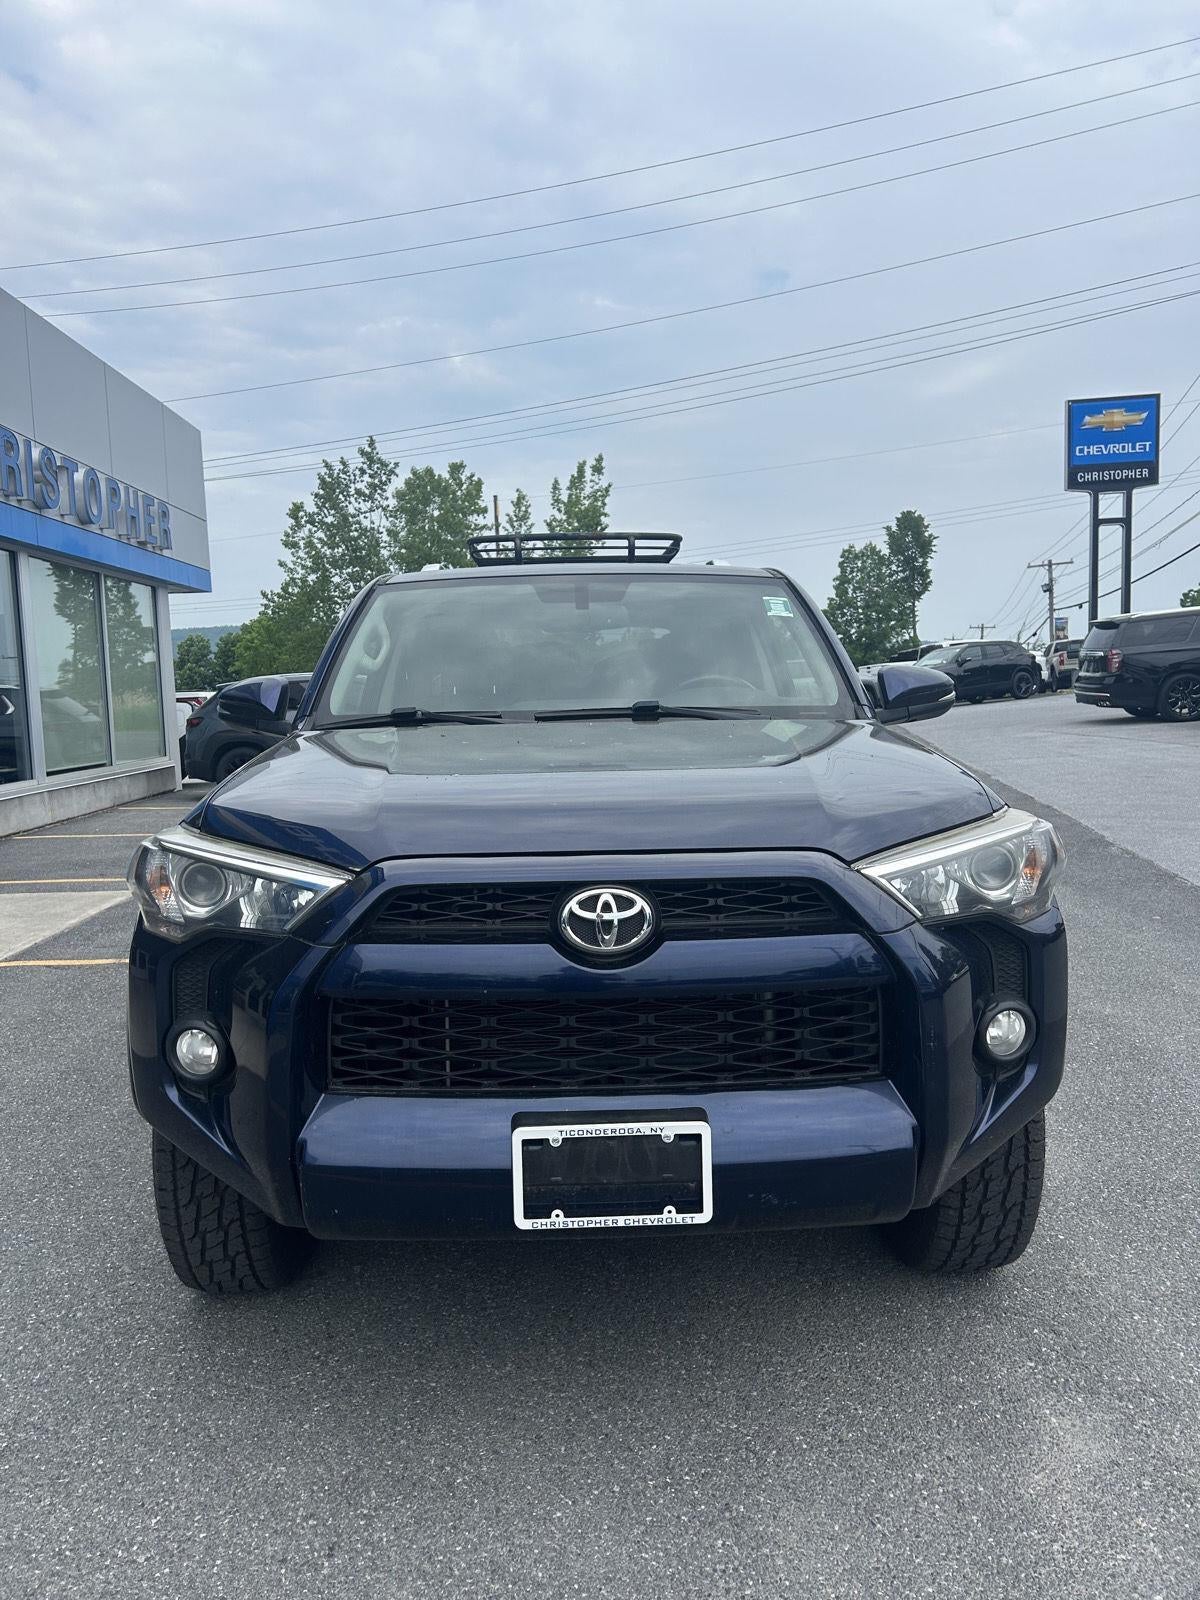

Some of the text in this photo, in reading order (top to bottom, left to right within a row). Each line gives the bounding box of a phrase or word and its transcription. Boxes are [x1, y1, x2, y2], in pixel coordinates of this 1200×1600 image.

[1075, 441, 1152, 456] CHEVROLET
[1077, 468, 1149, 482] CHRISTOPHER
[558, 1126, 665, 1136] TICONDEROGA, NY
[531, 1216, 696, 1229] CHRISTOPHER CHEVROLET
